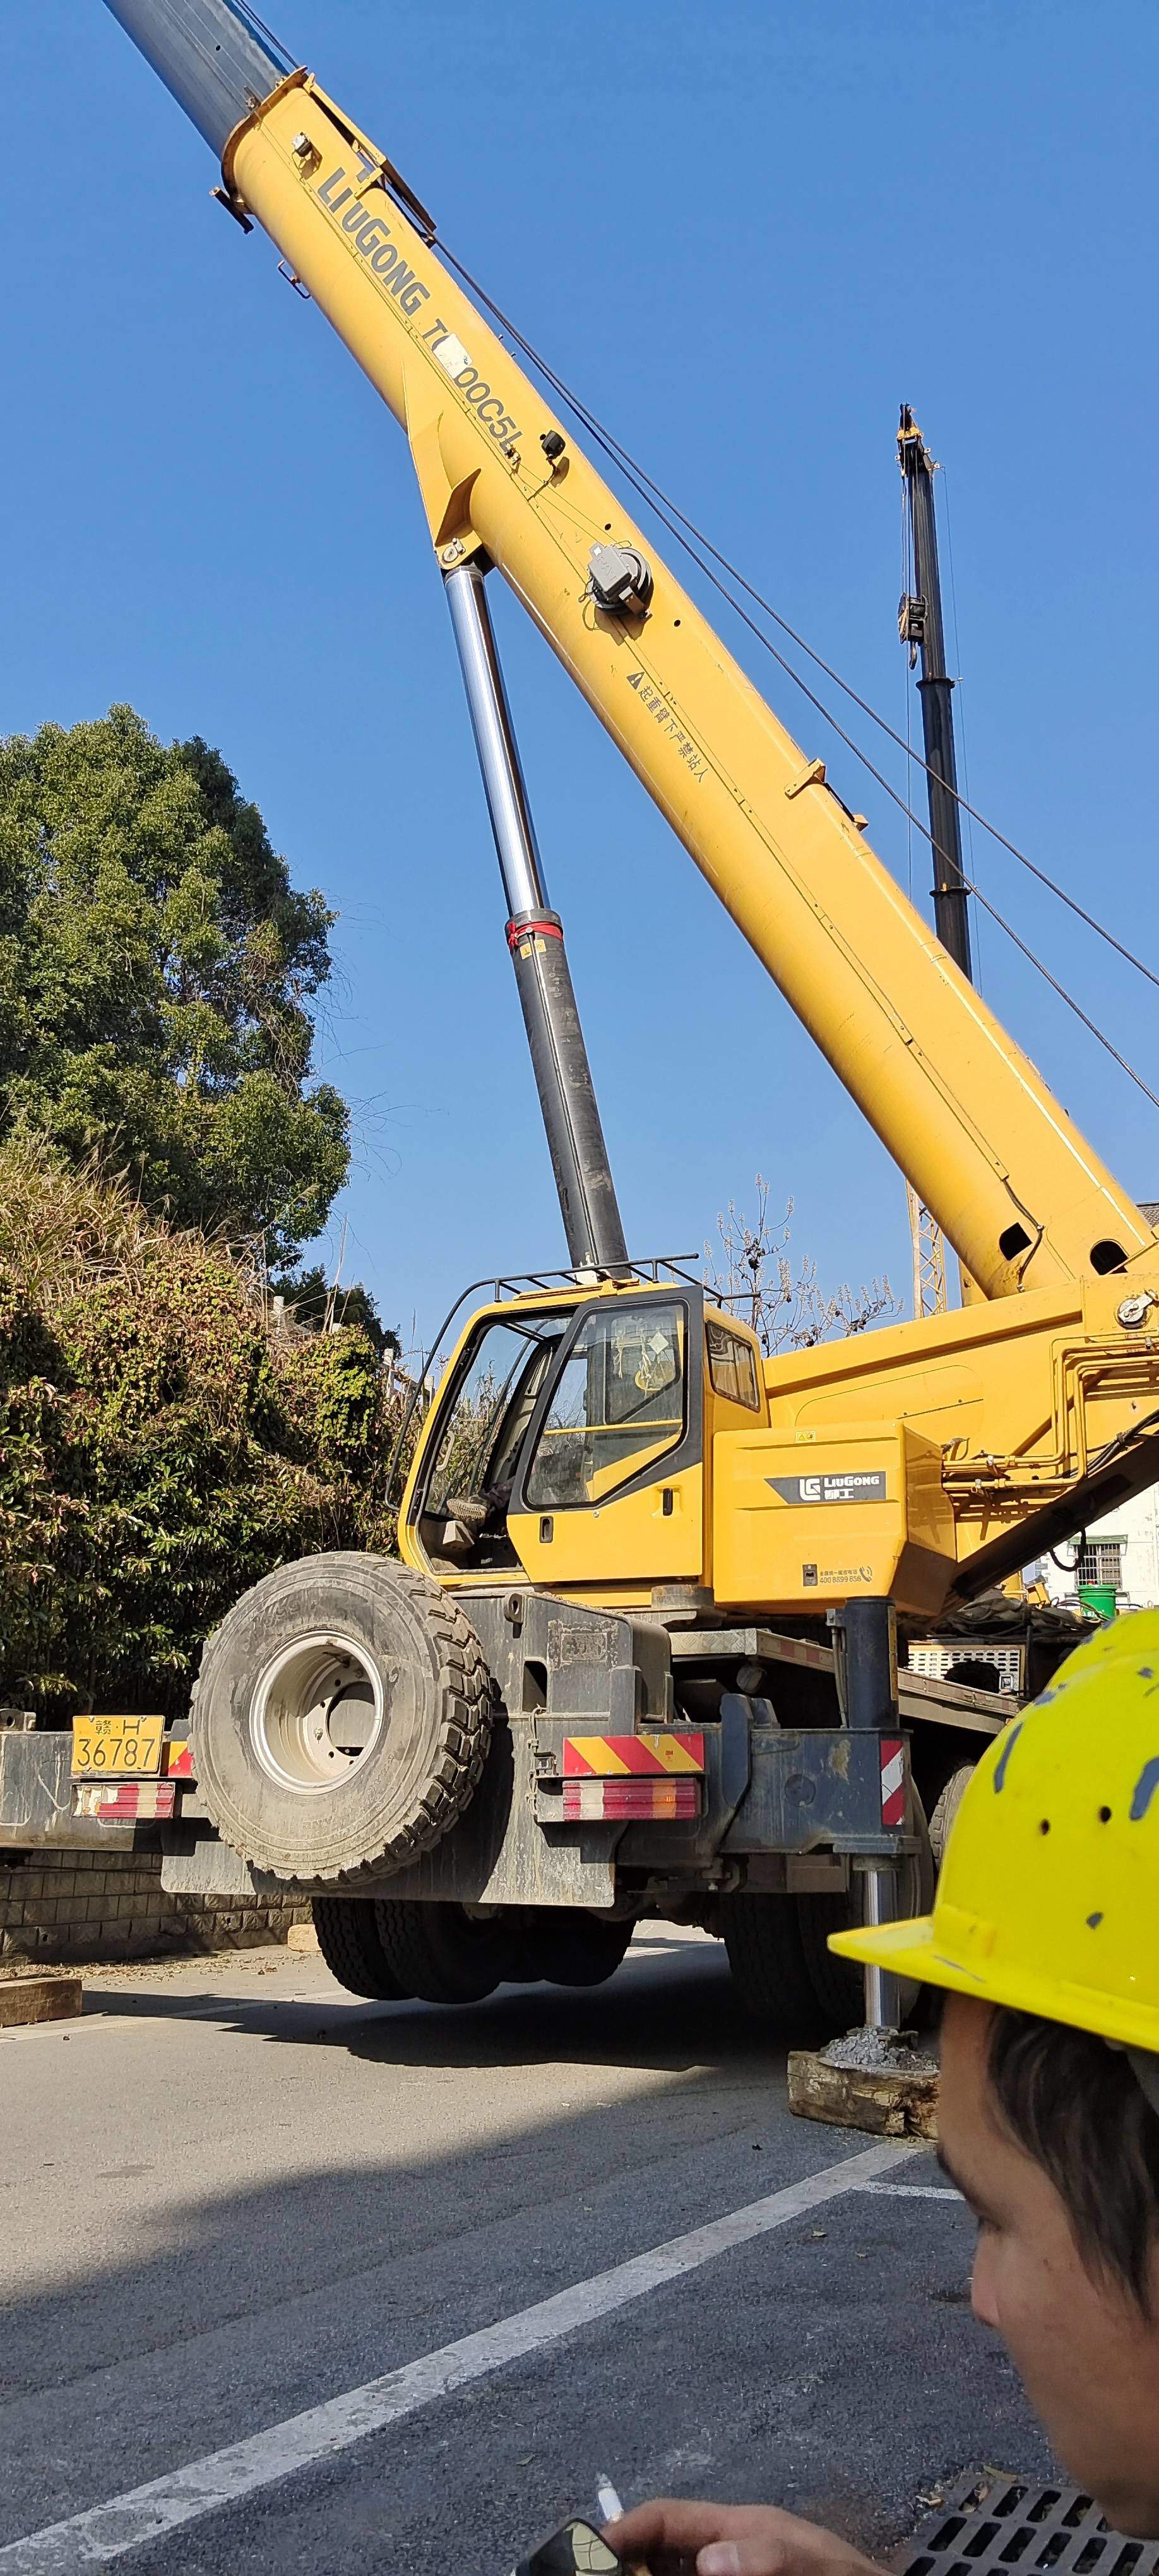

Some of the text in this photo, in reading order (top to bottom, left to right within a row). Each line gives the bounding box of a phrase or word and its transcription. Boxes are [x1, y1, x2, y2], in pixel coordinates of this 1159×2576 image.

[422, 318, 523, 453] T00C5L
[638, 686, 708, 783] 起重臂下严禁站人
[77, 1738, 155, 1767] 36787
